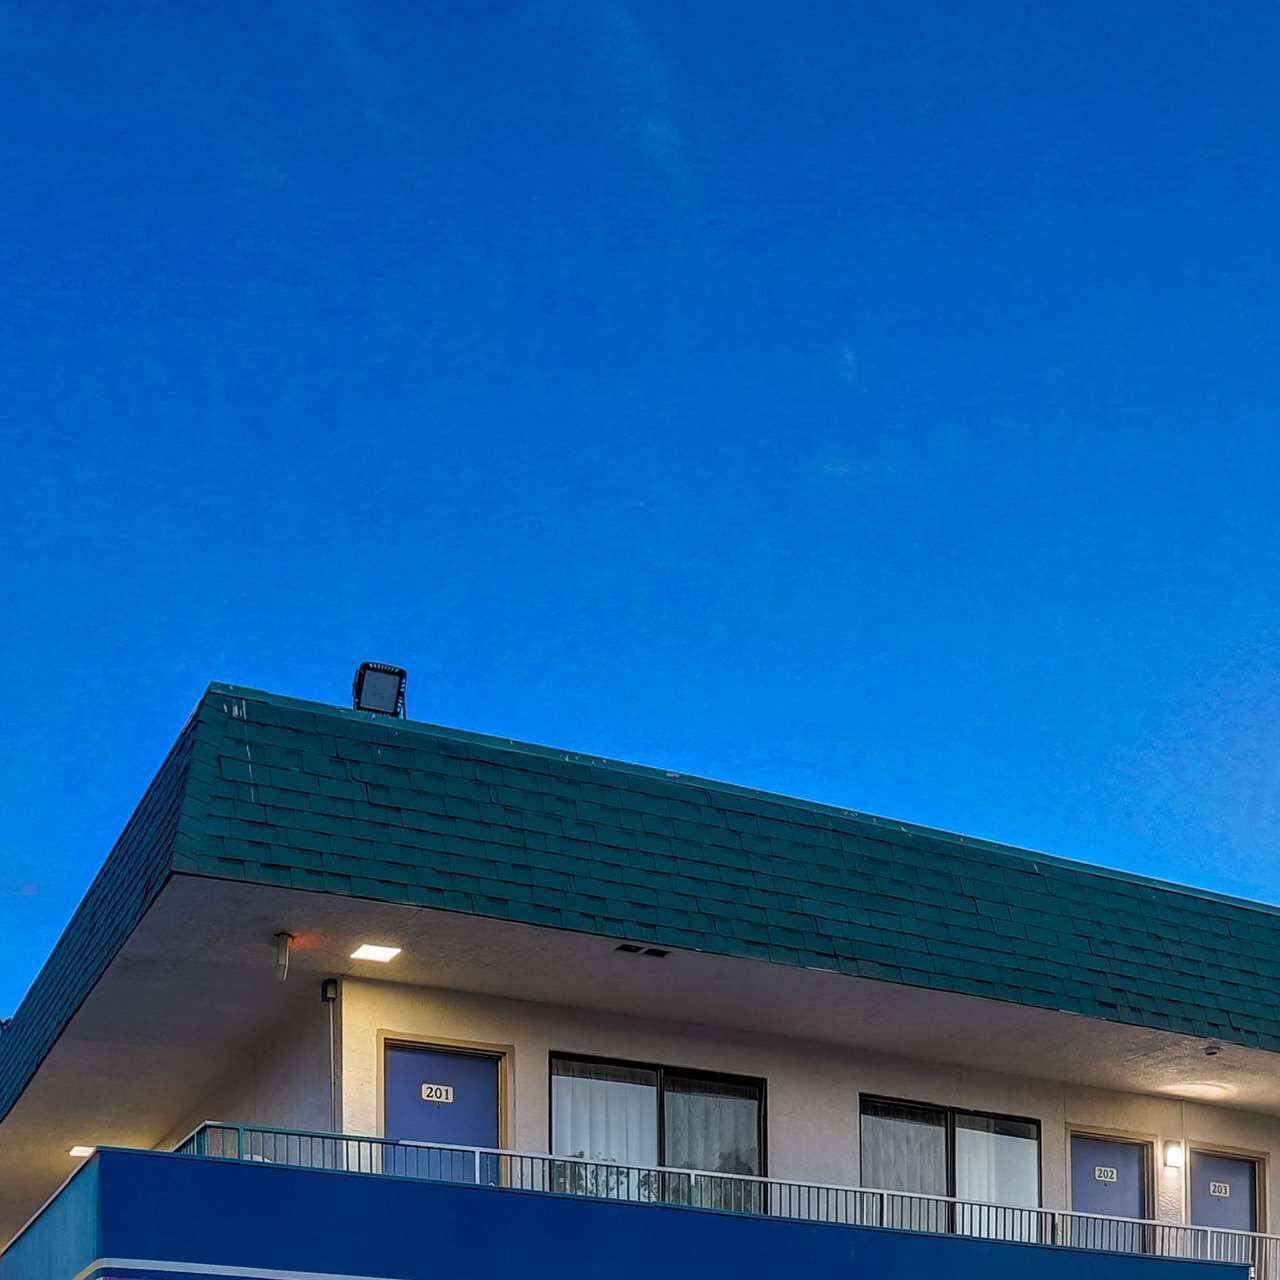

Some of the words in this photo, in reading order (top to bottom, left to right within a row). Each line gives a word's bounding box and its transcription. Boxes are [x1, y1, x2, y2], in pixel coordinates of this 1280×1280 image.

[426, 1086, 449, 1101] 201
[1097, 1168, 1115, 1180] 202
[1211, 1184, 1227, 1195] 203
